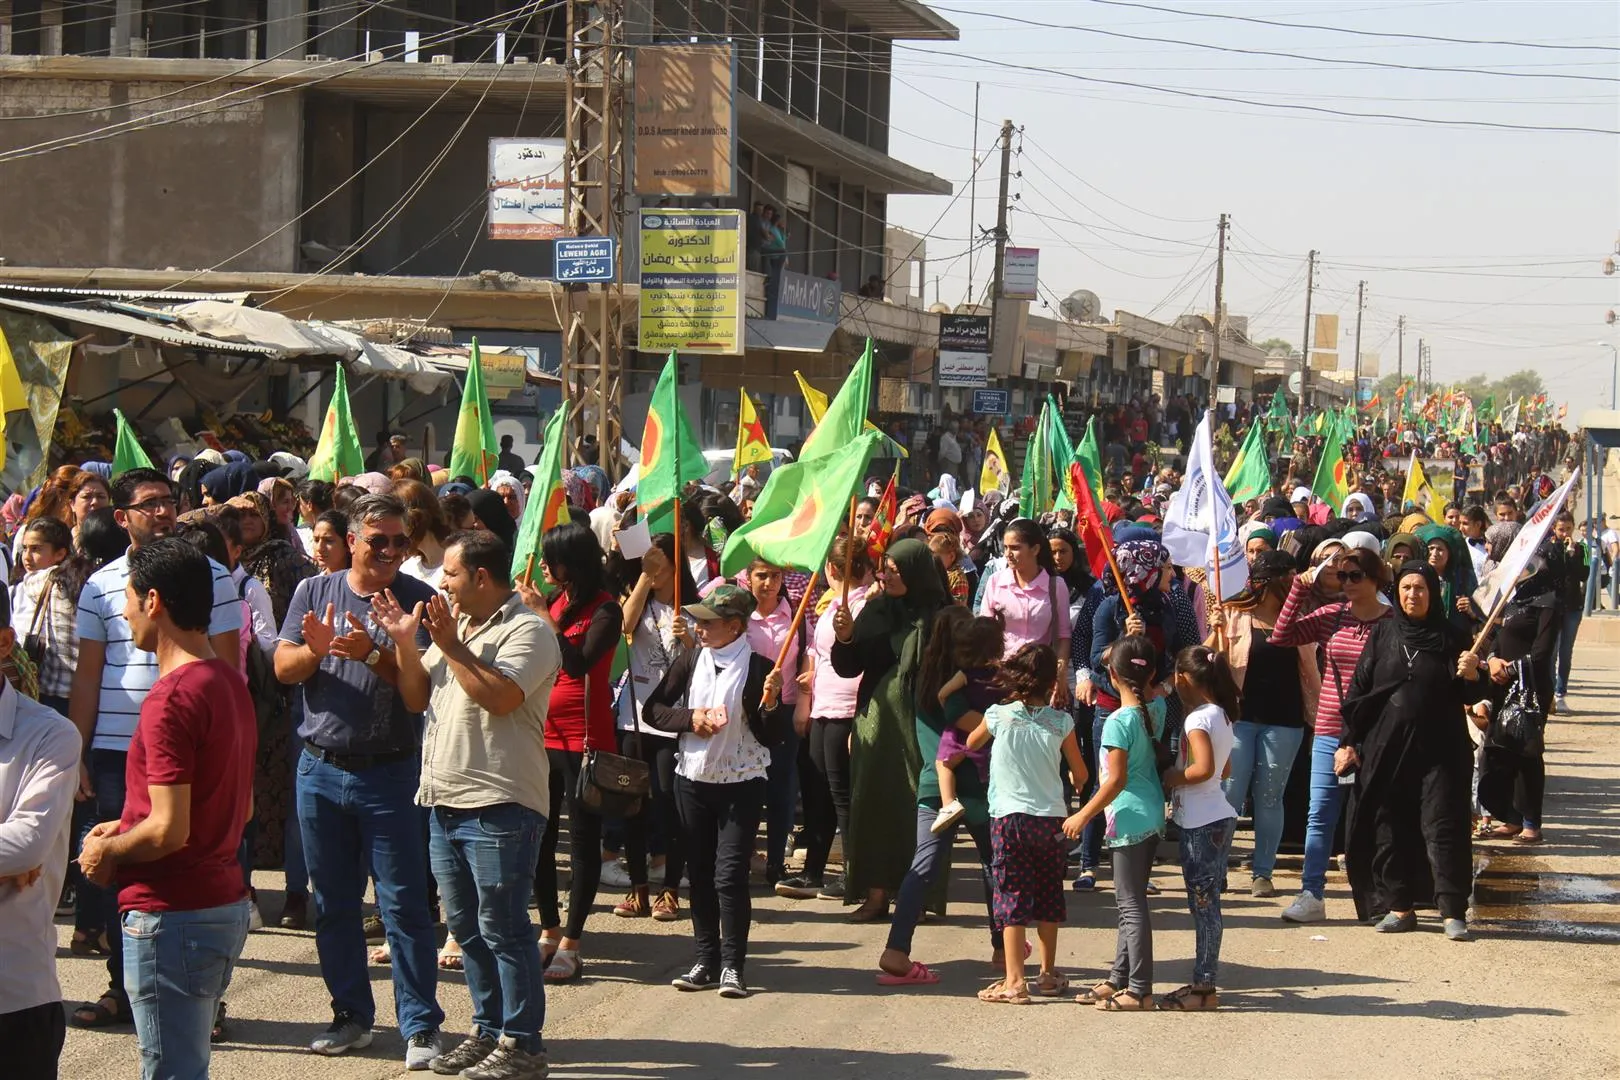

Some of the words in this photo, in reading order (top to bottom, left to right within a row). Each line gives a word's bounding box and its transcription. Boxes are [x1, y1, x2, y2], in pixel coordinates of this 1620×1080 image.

[517, 147, 546, 160] الدكتور
[668, 235, 710, 247] الدكتورة
[643, 253, 675, 266] رمضان
